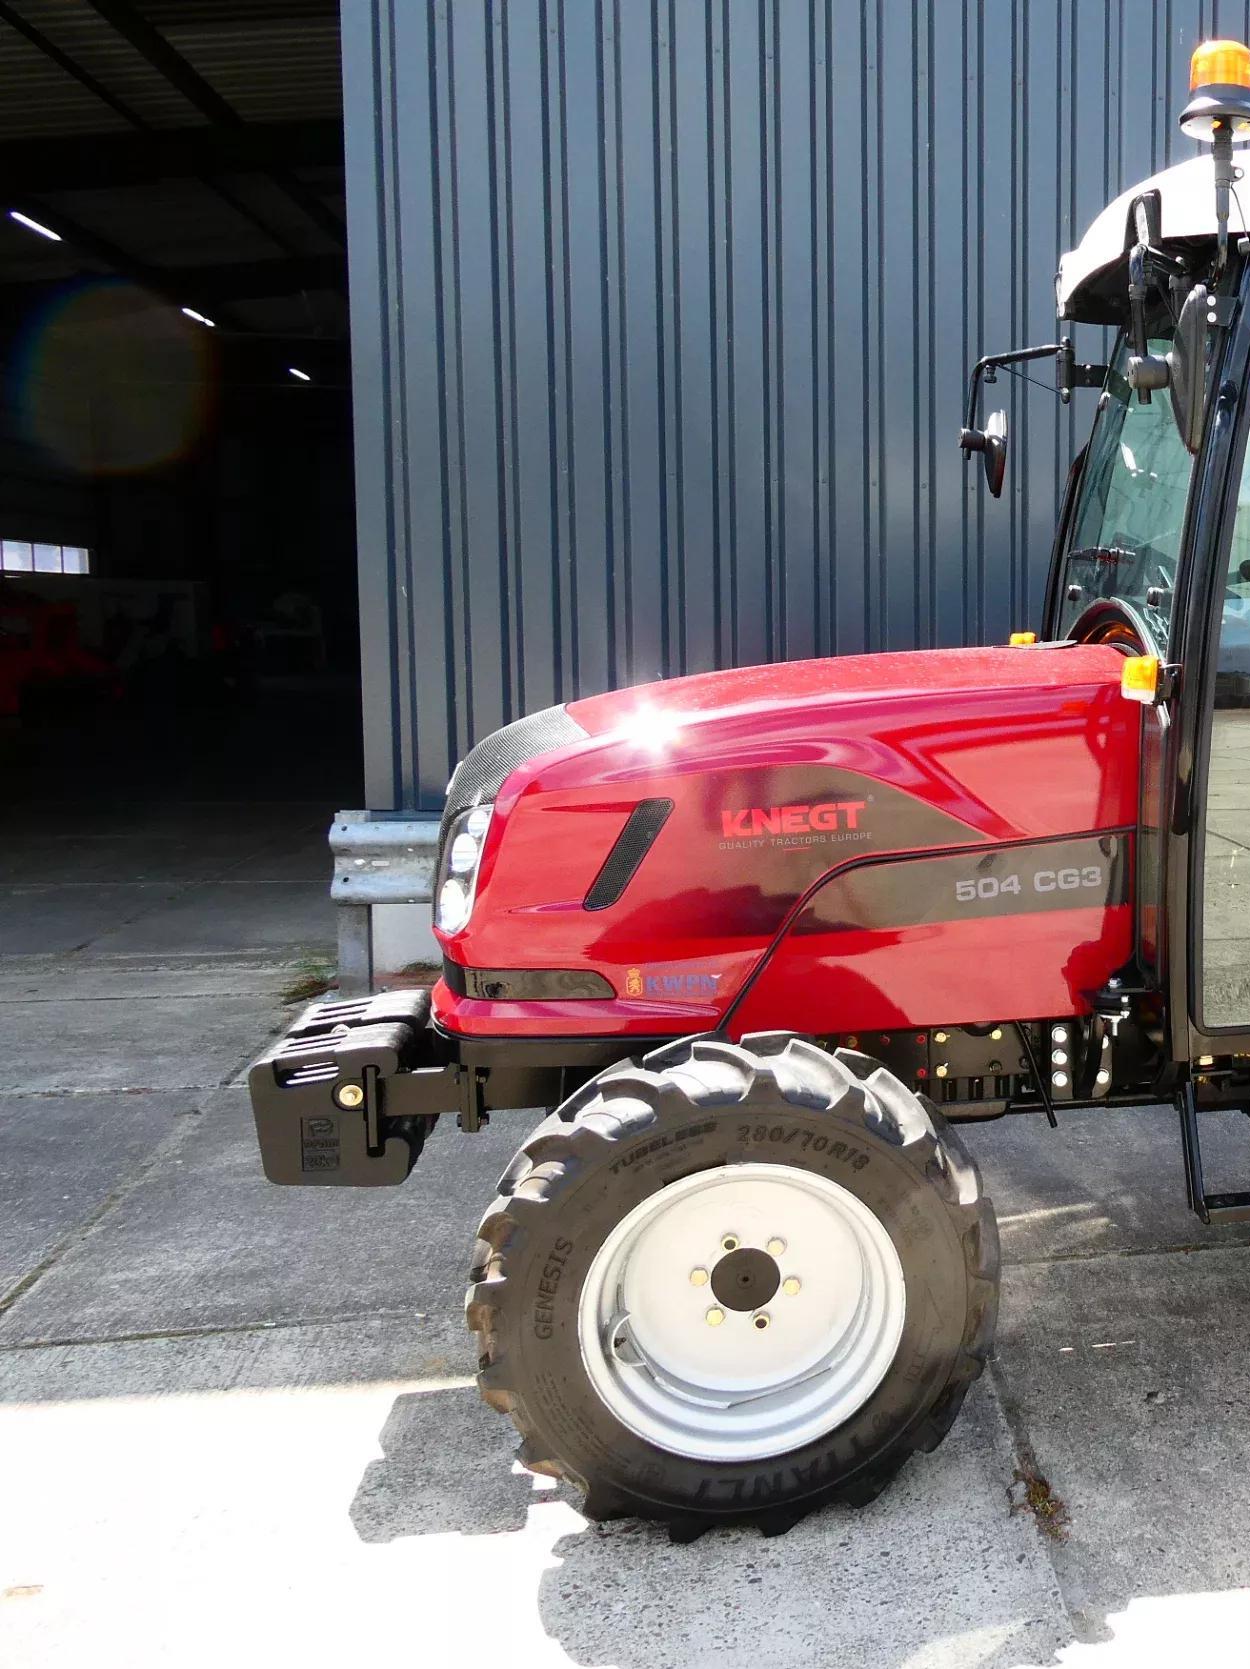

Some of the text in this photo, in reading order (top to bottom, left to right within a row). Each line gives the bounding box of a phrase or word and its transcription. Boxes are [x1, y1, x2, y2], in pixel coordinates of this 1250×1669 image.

[721, 801, 865, 838] KNEGT
[718, 832, 873, 850] QUALITY TRACTORS EUROPE
[955, 866, 1103, 902] 504 CG3
[534, 1236, 573, 1340] GENESIS
